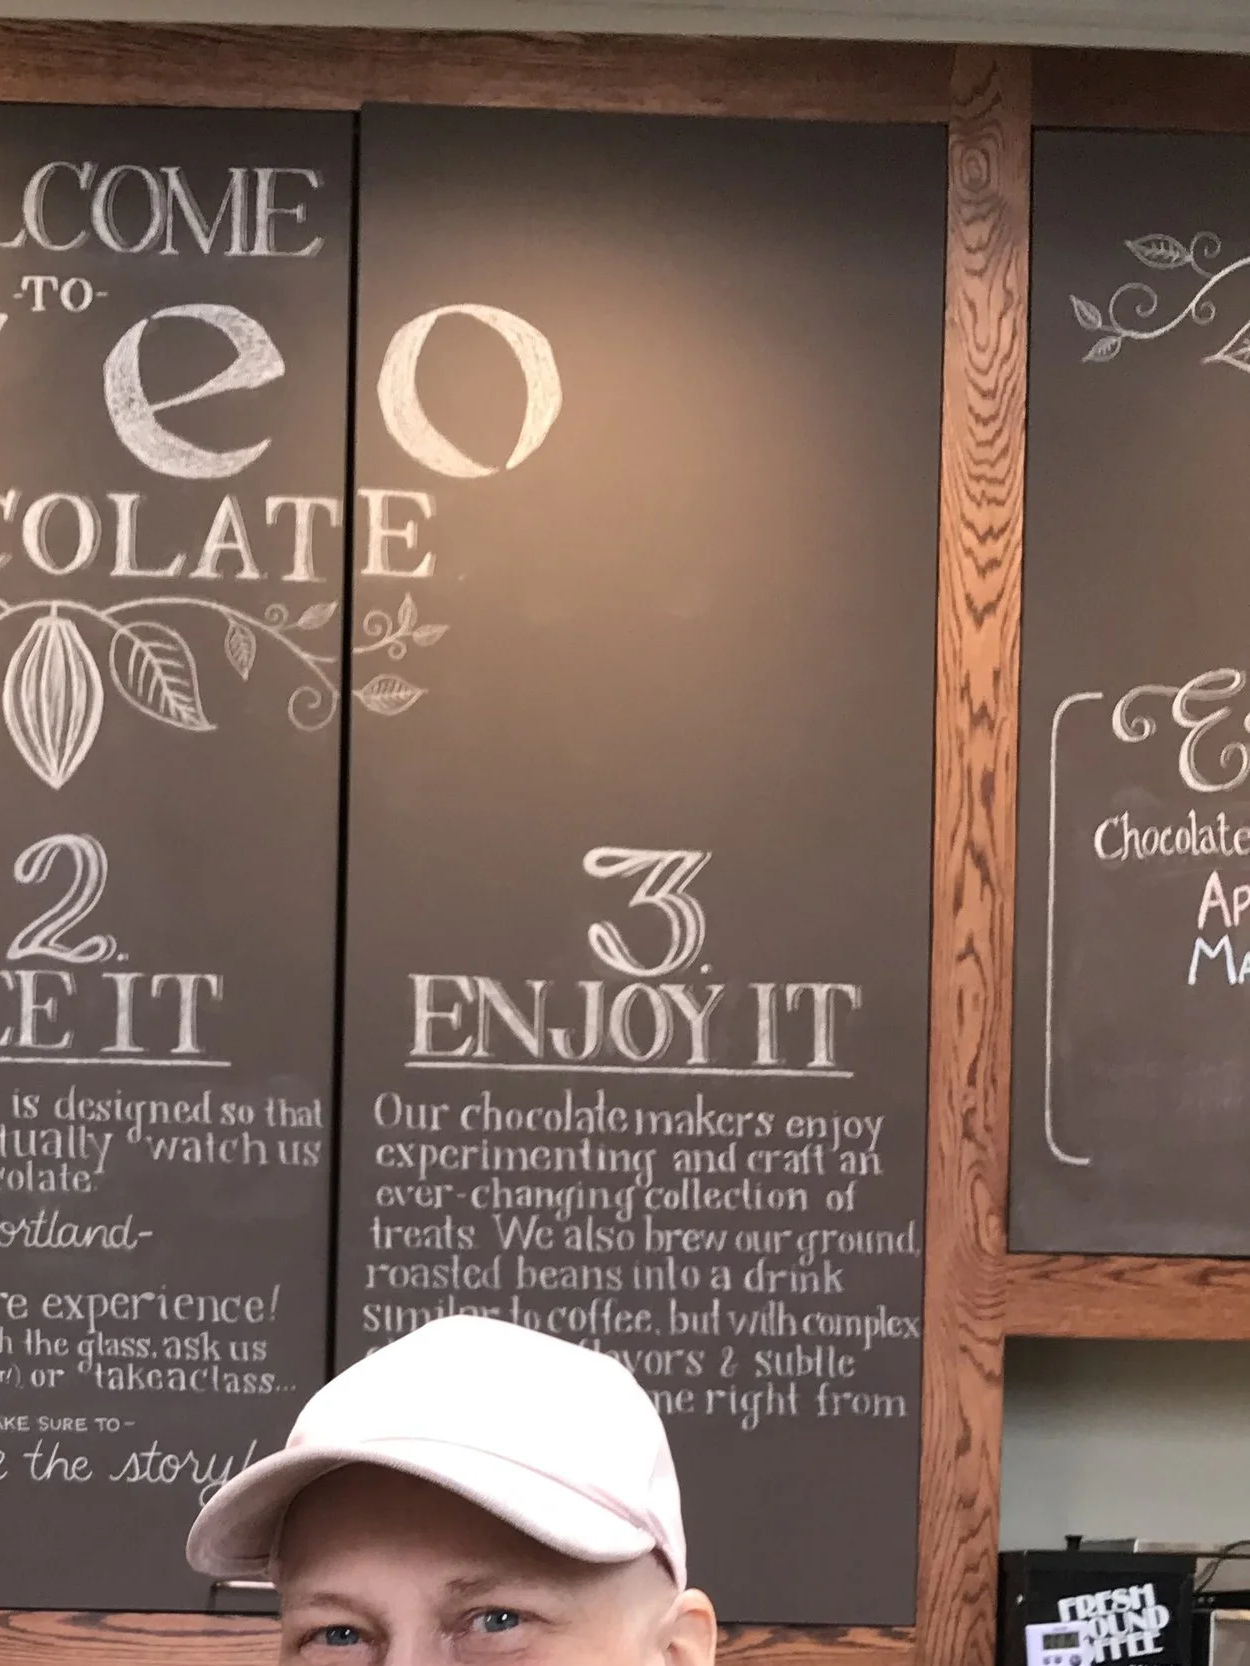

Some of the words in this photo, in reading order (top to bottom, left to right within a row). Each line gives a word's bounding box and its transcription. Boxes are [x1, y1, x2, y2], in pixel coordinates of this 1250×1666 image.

[1094, 809, 1250, 861] Chocolate
[100, 971, 224, 1054] IT
[408, 972, 726, 1065] ENJOY
[749, 982, 863, 1069] IT
[10, 1087, 40, 1119] is
[53, 1083, 213, 1144] designed
[219, 1102, 256, 1126] so
[264, 1096, 324, 1128] that
[374, 1091, 450, 1131] Our
[459, 1088, 629, 1134] chocolate
[634, 1093, 776, 1138] makers
[784, 1109, 886, 1152] enjoy
[146, 1130, 269, 1166] watch
[277, 1139, 321, 1167] us
[375, 1138, 656, 1189] experimenting
[672, 1141, 737, 1174] and
[746, 1141, 826, 1175] craft
[838, 1149, 885, 1175] an
[376, 1176, 636, 1223] ever-changing
[644, 1177, 808, 1212] collection
[825, 1179, 858, 1212] of
[492, 1213, 555, 1250] We
[564, 1214, 637, 1252] also
[643, 1213, 728, 1253] brew
[734, 1229, 793, 1253] our
[365, 1253, 501, 1290] roasted
[516, 1254, 624, 1291] beans
[632, 1256, 701, 1291] into
[710, 1265, 733, 1292] a
[743, 1256, 846, 1294] drink
[41, 1283, 281, 1334] experience!
[669, 1297, 721, 1335] but
[726, 1299, 798, 1336] with
[801, 1304, 921, 1351] complex
[24, 1327, 69, 1357] the
[162, 1331, 222, 1362] ask
[228, 1340, 268, 1361] us
[579, 1337, 705, 1377] vors
[754, 1344, 857, 1378] subtle
[30, 1368, 66, 1389] or
[93, 1362, 164, 1392] take
[165, 1369, 186, 1392] a
[38, 1416, 89, 1433] SURE
[706, 1381, 801, 1431] right
[817, 1382, 908, 1417] from
[22, 1438, 94, 1482] the
